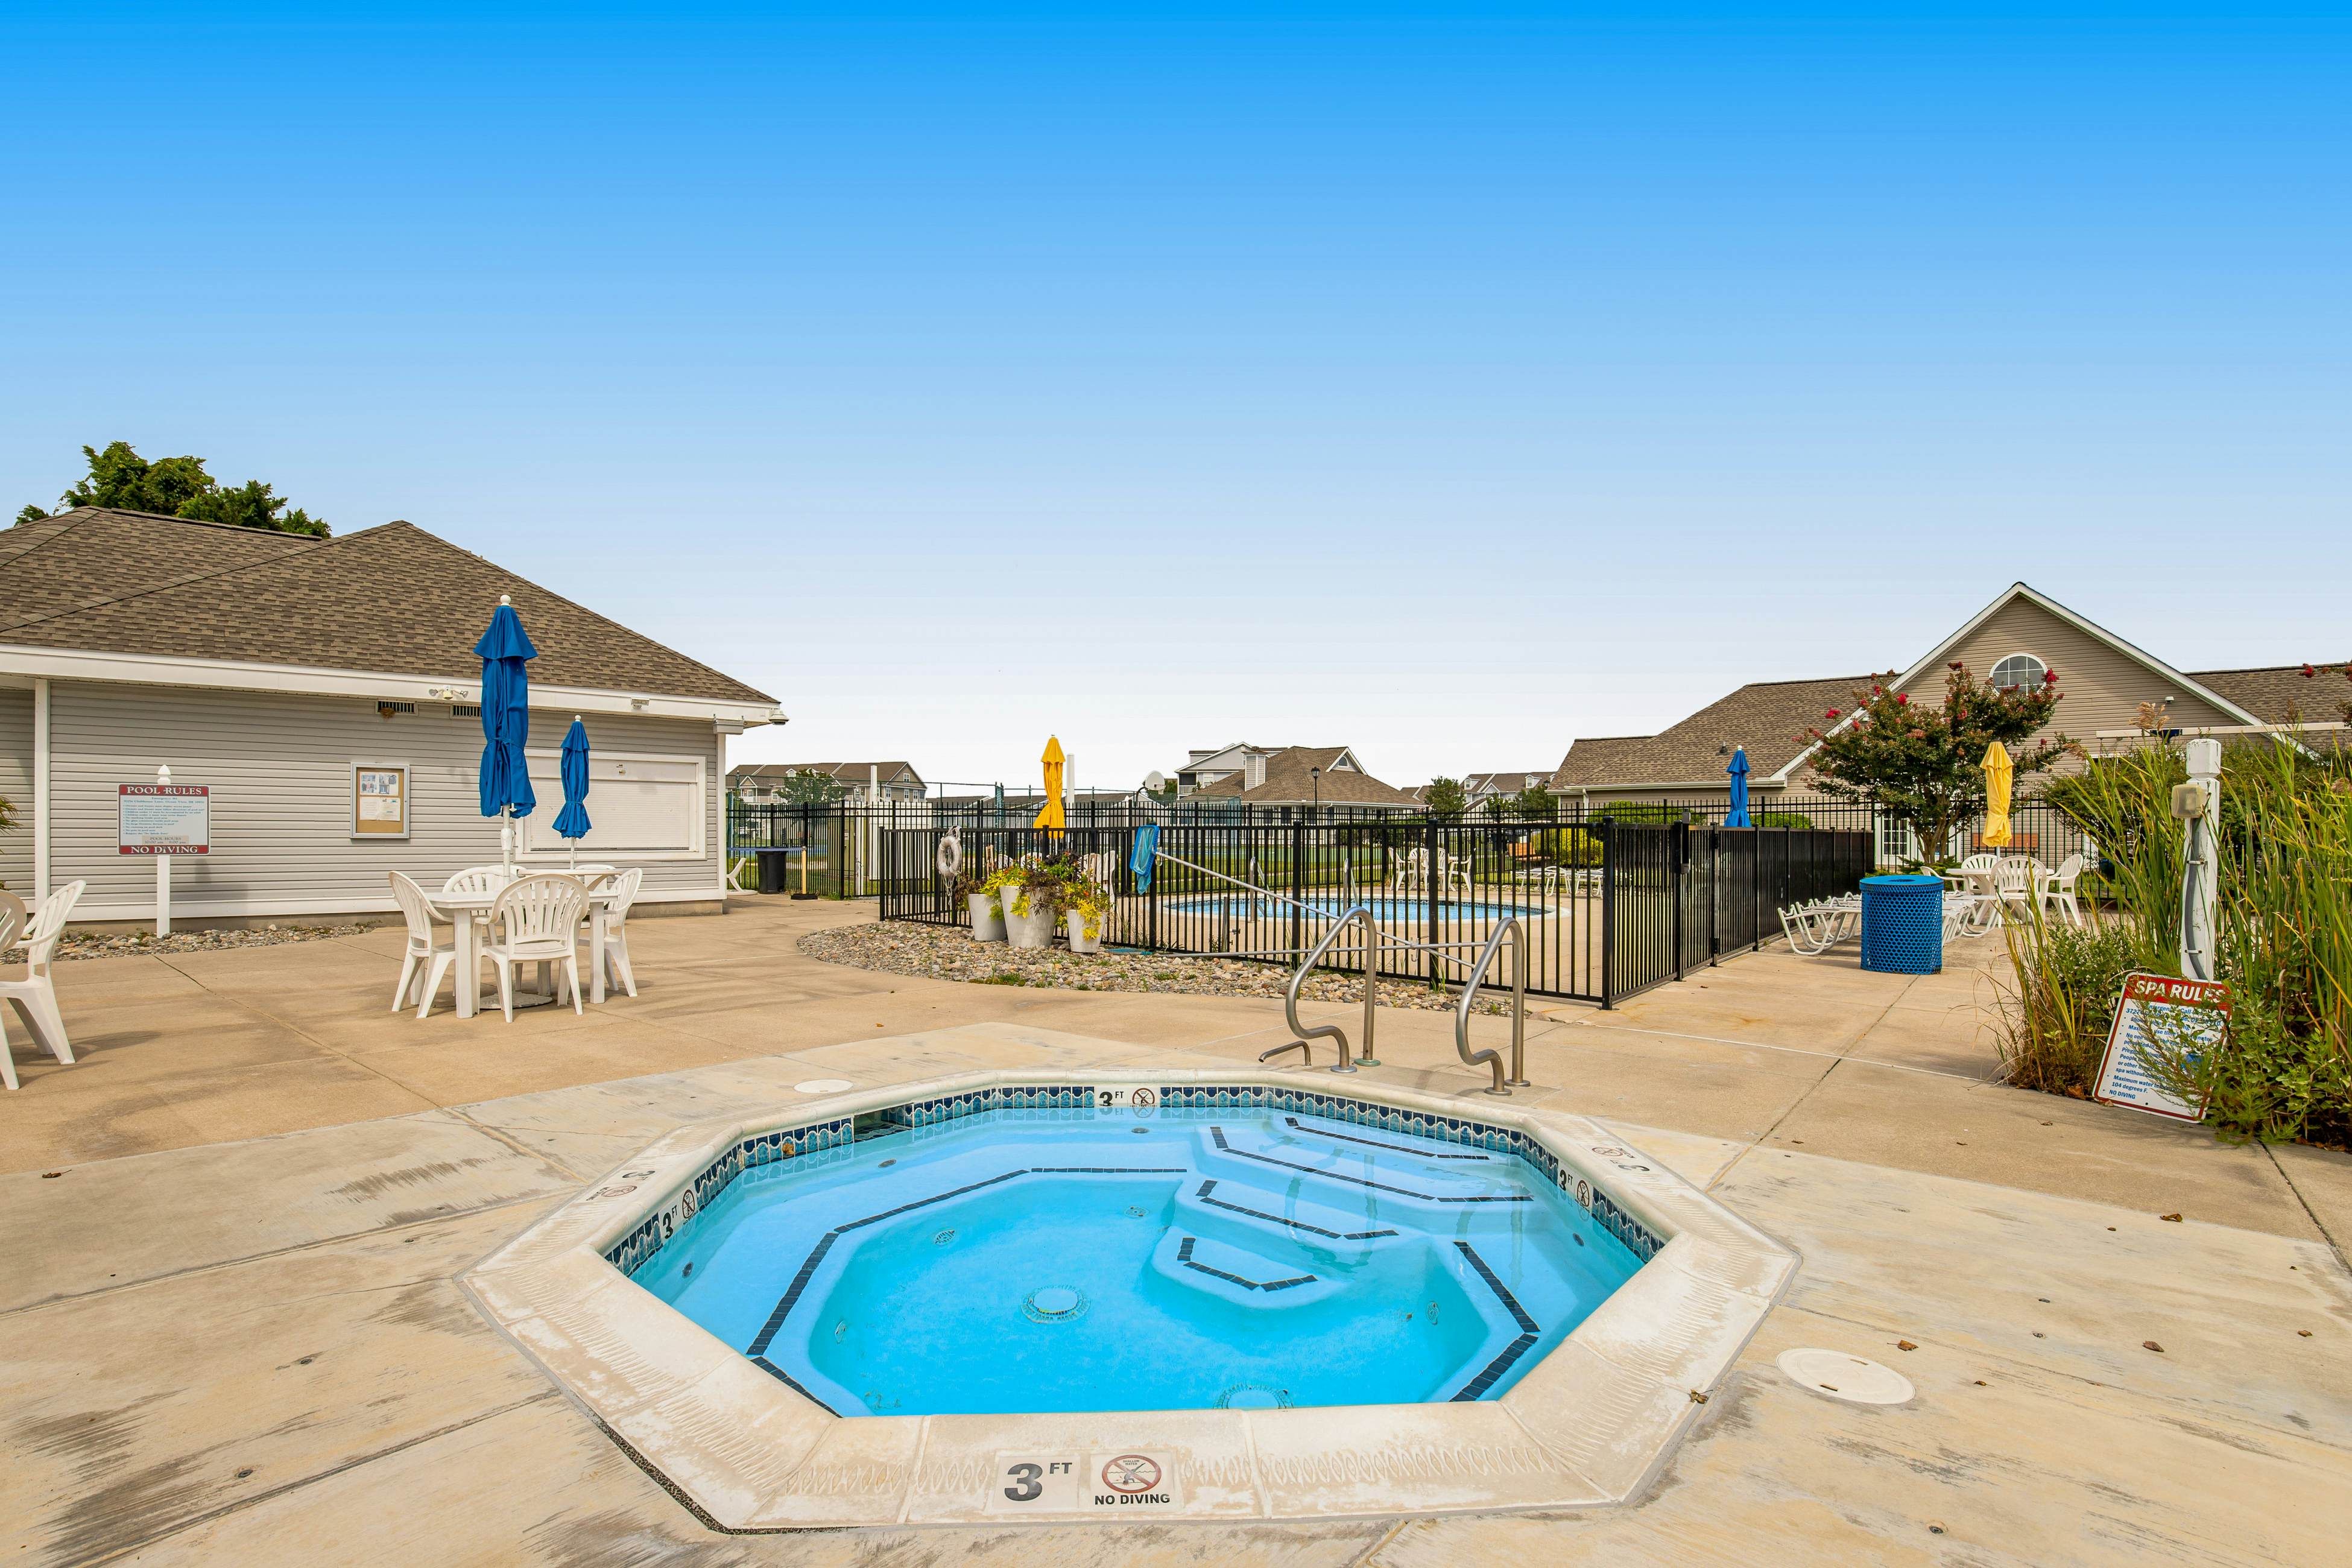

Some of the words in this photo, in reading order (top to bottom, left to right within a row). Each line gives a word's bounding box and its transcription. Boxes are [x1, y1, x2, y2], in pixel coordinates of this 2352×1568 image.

[127, 786, 160, 794] POOL
[2134, 980, 2166, 997] SPA
[2113, 1075, 2138, 1084] Maximum
[1099, 1091, 1113, 1107] 3
[1558, 1169, 1567, 1191] 3
[1567, 1173, 1573, 1186] FT
[663, 1212, 674, 1239] 3
[671, 1204, 677, 1218] FT
[1004, 1463, 1043, 1501] 3
[1049, 1462, 1072, 1475] FT
[1095, 1495, 1115, 1505] NO
[1120, 1493, 1171, 1505] DIVING
